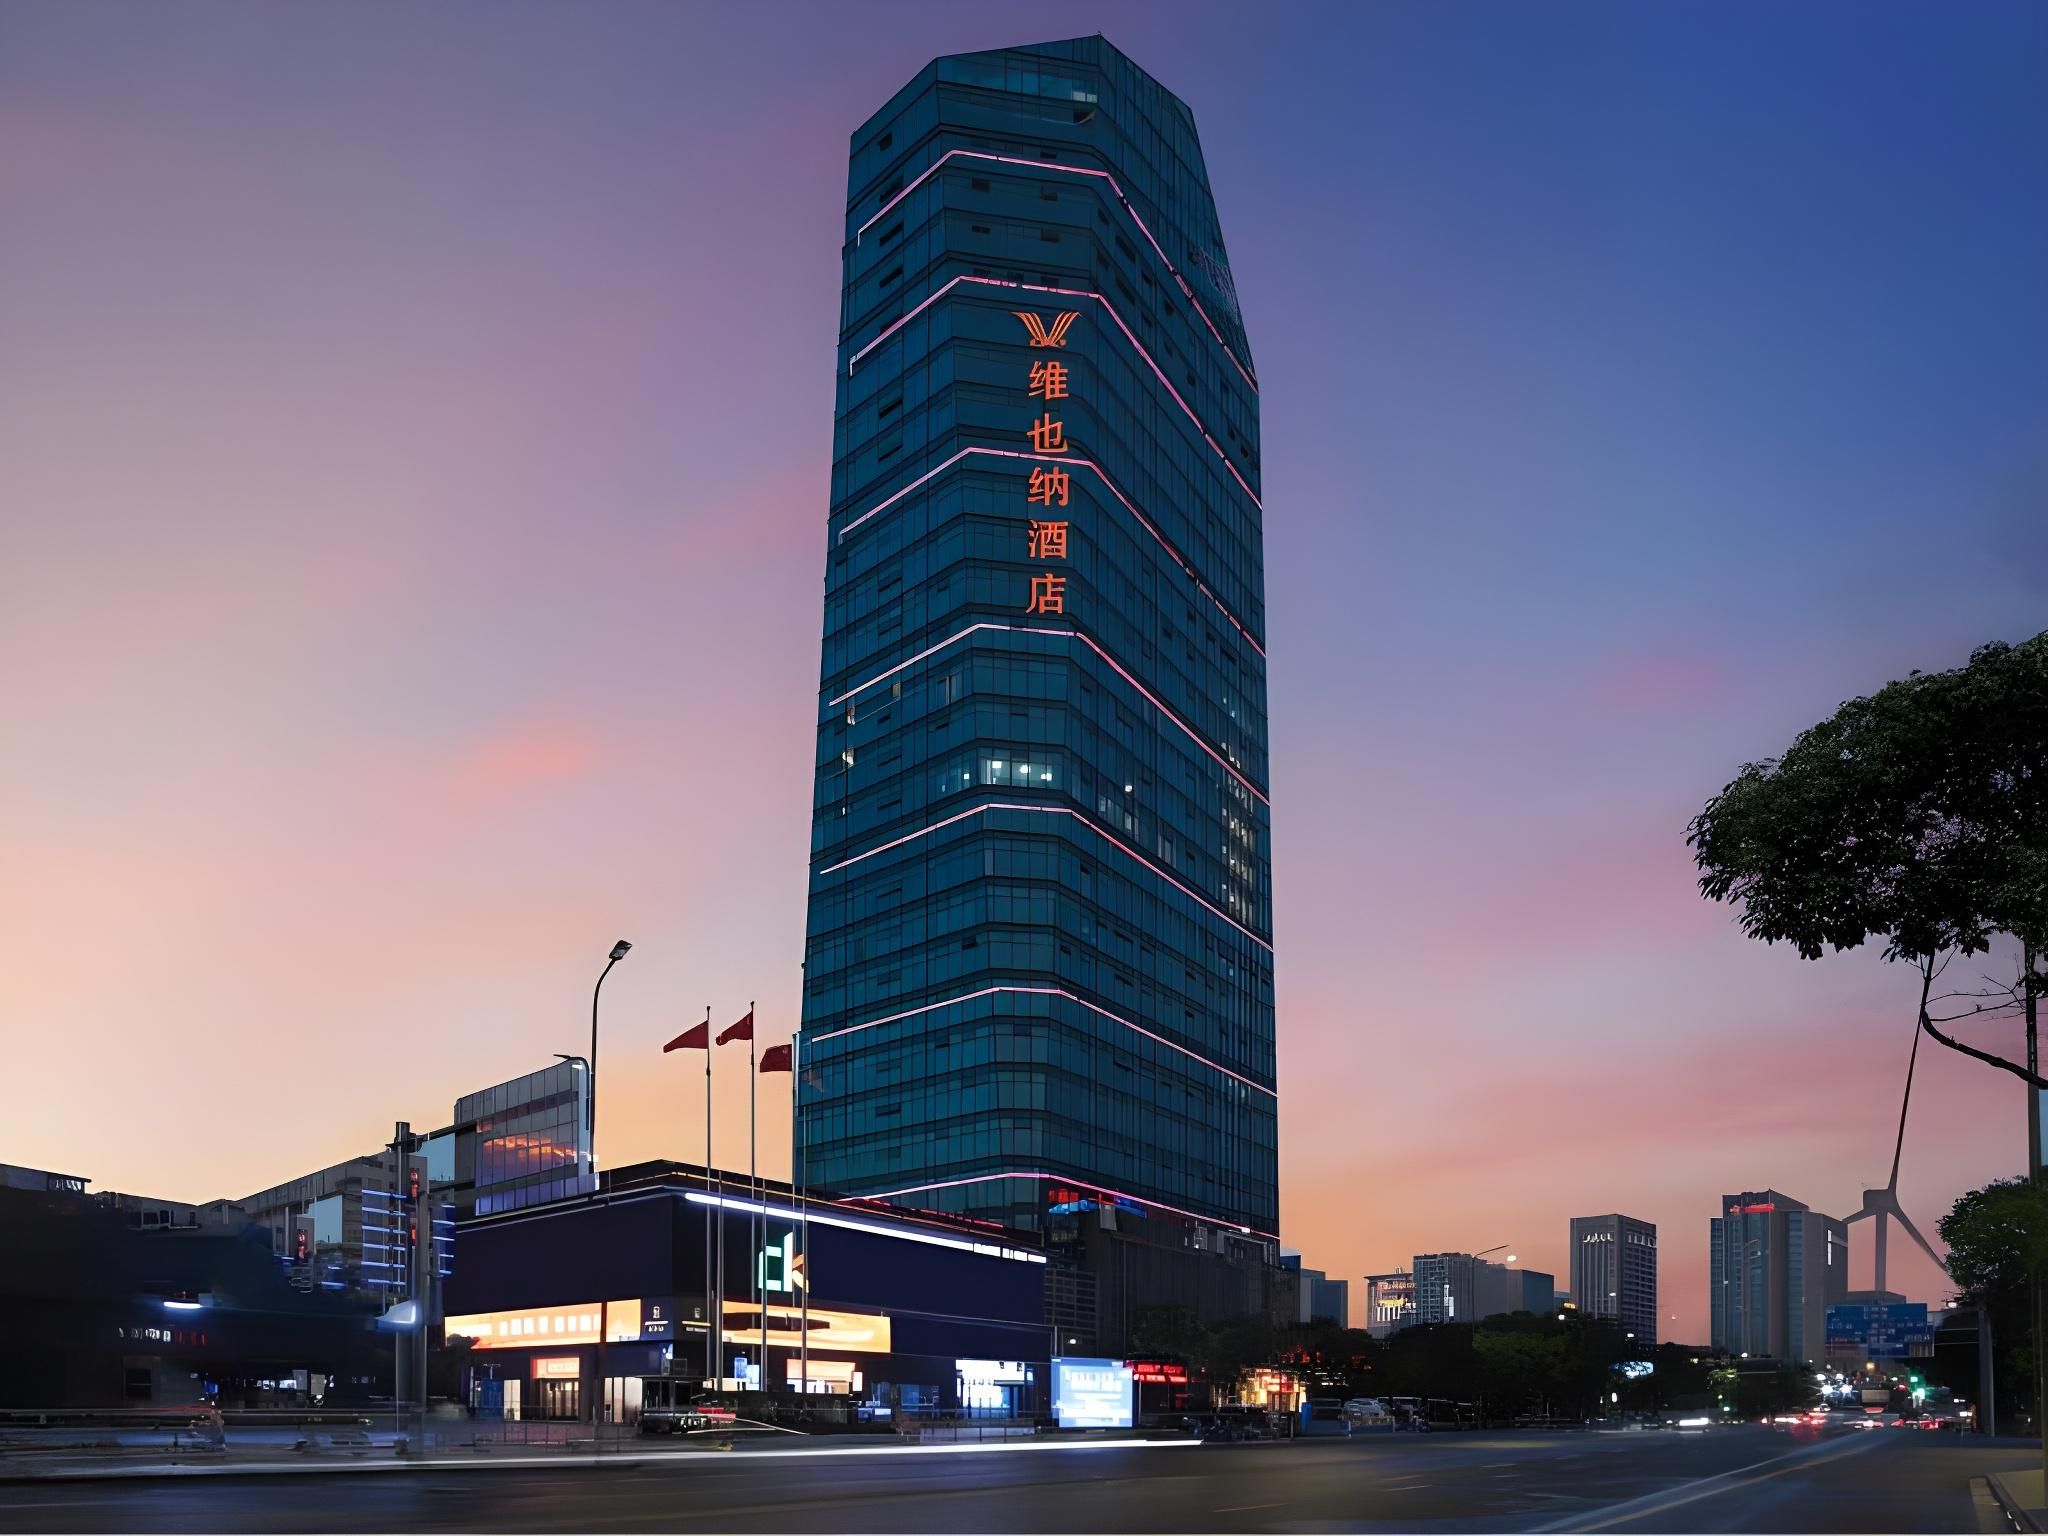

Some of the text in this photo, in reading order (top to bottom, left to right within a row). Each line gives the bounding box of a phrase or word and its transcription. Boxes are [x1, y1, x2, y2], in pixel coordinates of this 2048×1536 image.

[1026, 360, 1070, 614] 维也纳酒店
